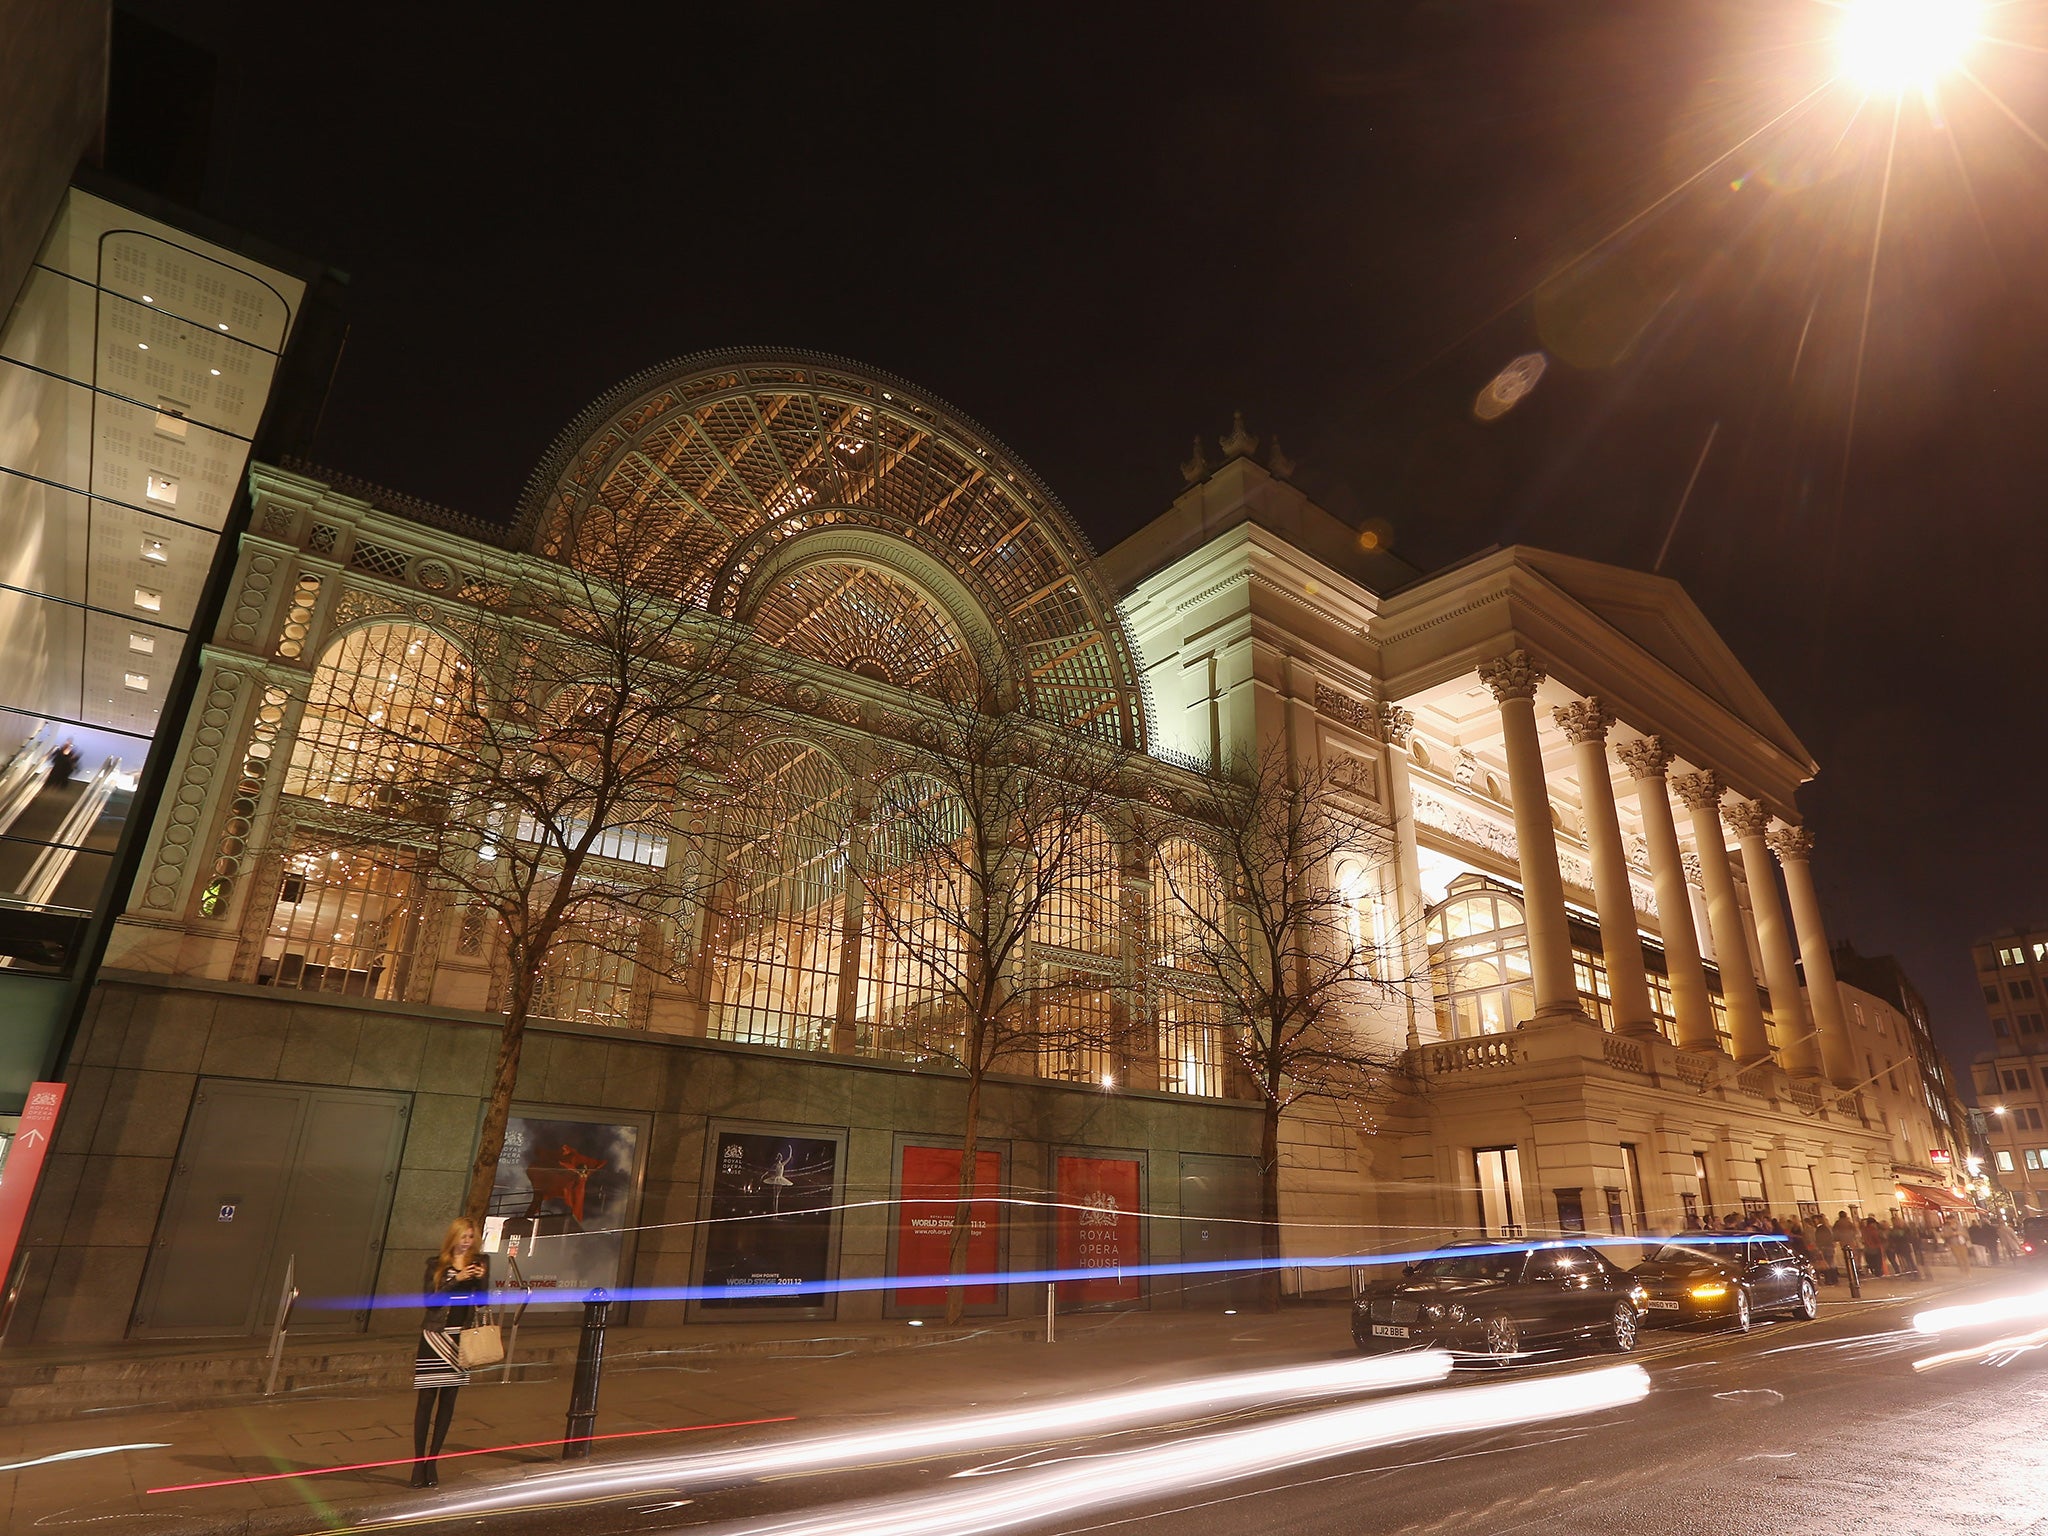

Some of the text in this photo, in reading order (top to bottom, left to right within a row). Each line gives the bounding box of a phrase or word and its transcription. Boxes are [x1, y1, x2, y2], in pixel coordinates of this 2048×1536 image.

[911, 1219, 938, 1228] WORLD
[938, 1219, 955, 1228] STAG
[1079, 1230, 1119, 1241] ROYAL
[1079, 1244, 1119, 1255] OPERA
[1079, 1258, 1119, 1269] HOUSE
[495, 1280, 529, 1288] WRLD
[529, 1280, 558, 1288] STAGE
[726, 1278, 754, 1286] WORLD
[753, 1278, 777, 1286] STAGE
[777, 1278, 794, 1286] 2011
[1374, 1326, 1404, 1337] LJ12 BBE
